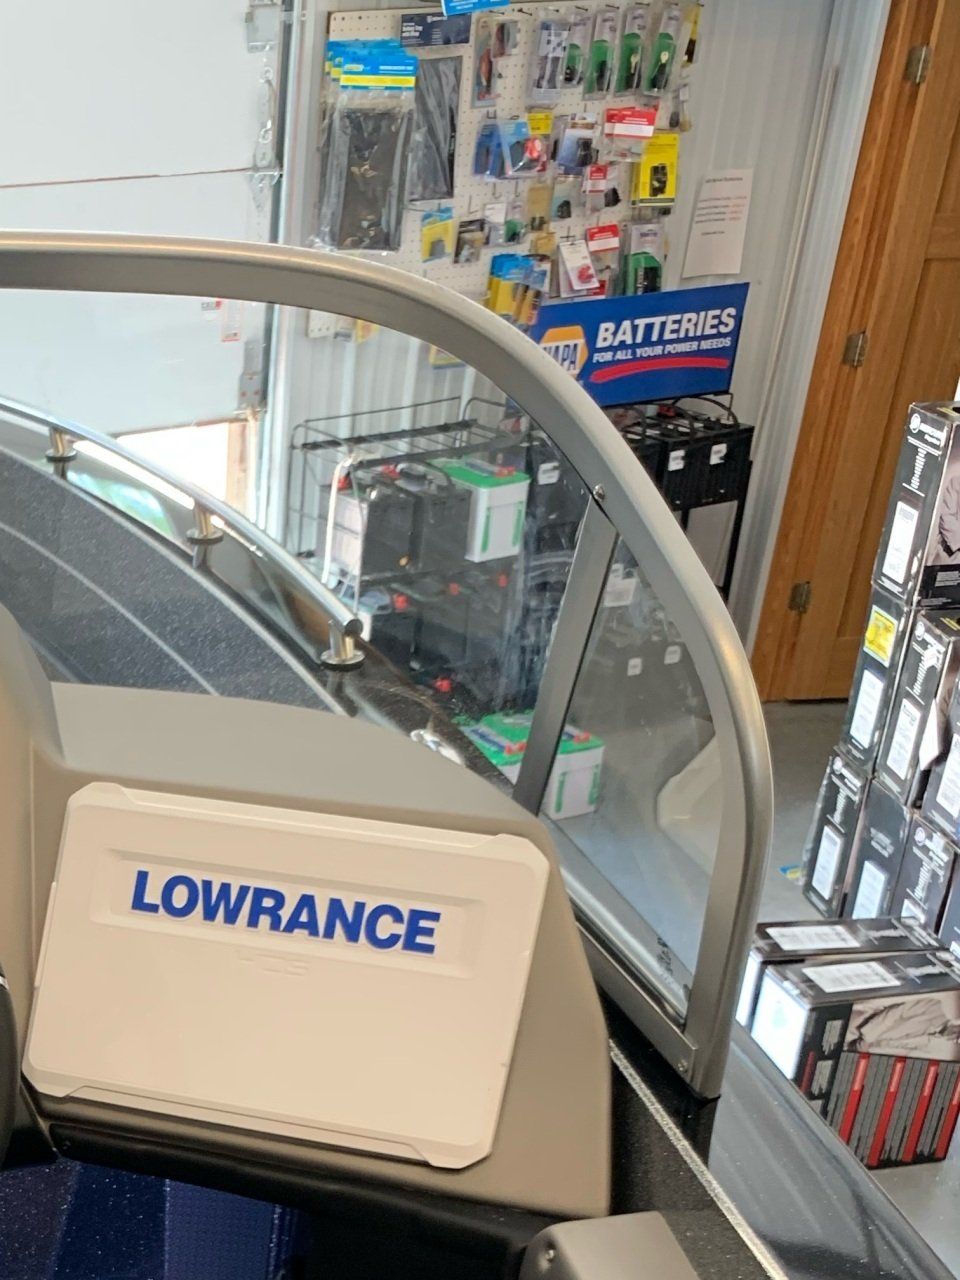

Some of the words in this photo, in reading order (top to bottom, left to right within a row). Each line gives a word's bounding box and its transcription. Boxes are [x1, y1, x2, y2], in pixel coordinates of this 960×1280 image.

[595, 307, 737, 349] BATTERIES
[592, 352, 613, 364] FOR
[615, 349, 633, 360] ALL
[634, 346, 663, 358] YOUR
[664, 342, 698, 355] POWER
[699, 337, 732, 350] NEEDS
[130, 869, 441, 954] LOWRANCE
